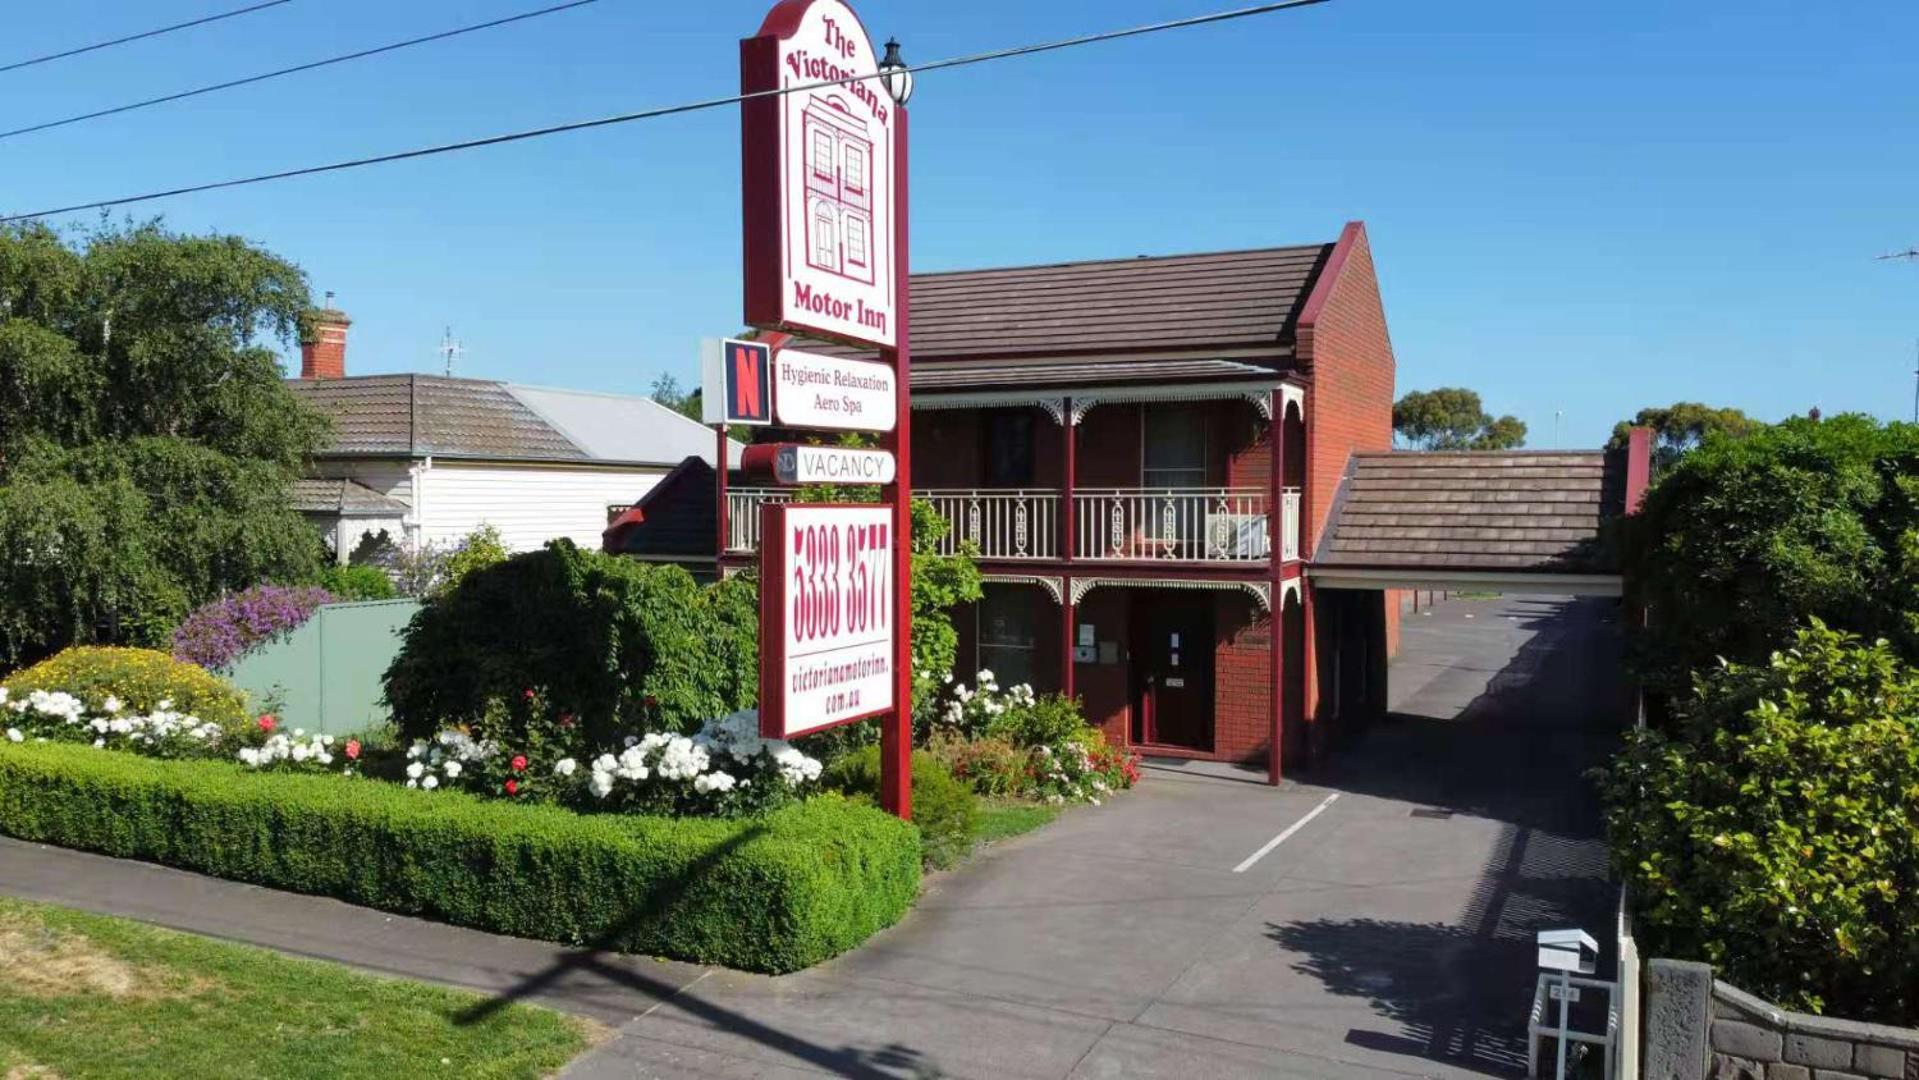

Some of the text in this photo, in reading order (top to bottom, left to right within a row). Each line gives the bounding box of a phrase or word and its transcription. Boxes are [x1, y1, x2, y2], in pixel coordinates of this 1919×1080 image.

[822, 13, 855, 59] The
[786, 50, 888, 126] Victoriana
[794, 281, 886, 335] Motor Inn
[782, 363, 889, 392] Hygienic Relaxation
[814, 394, 862, 414] Aero Spa
[804, 453, 885, 478] VACANCY
[794, 523, 887, 643] 5333 3577
[792, 652, 889, 694] victorianamotorinn.
[826, 689, 860, 715] com.au
